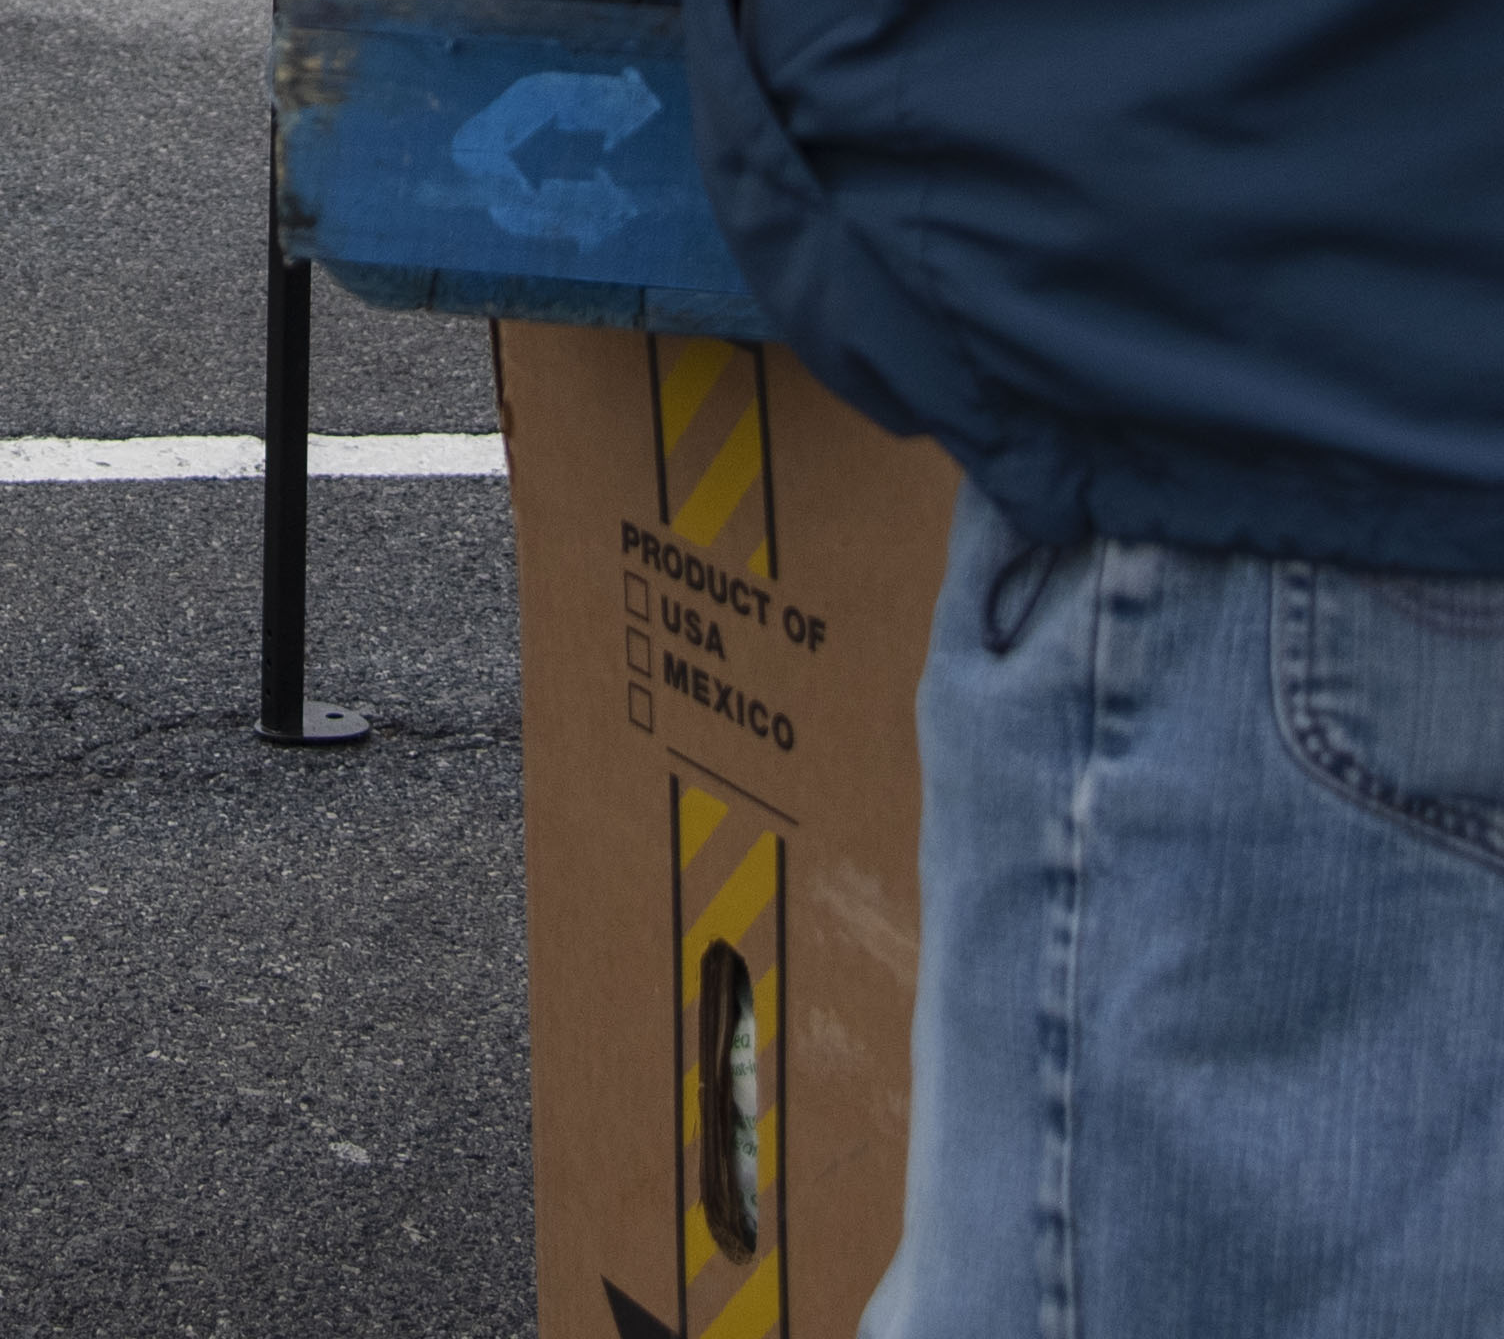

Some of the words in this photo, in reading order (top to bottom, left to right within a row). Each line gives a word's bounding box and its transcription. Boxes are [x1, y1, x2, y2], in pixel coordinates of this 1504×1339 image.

[621, 520, 771, 626] PRODUCT
[781, 606, 827, 653] OF
[661, 594, 726, 660] USA
[664, 651, 796, 752] MEXICO
